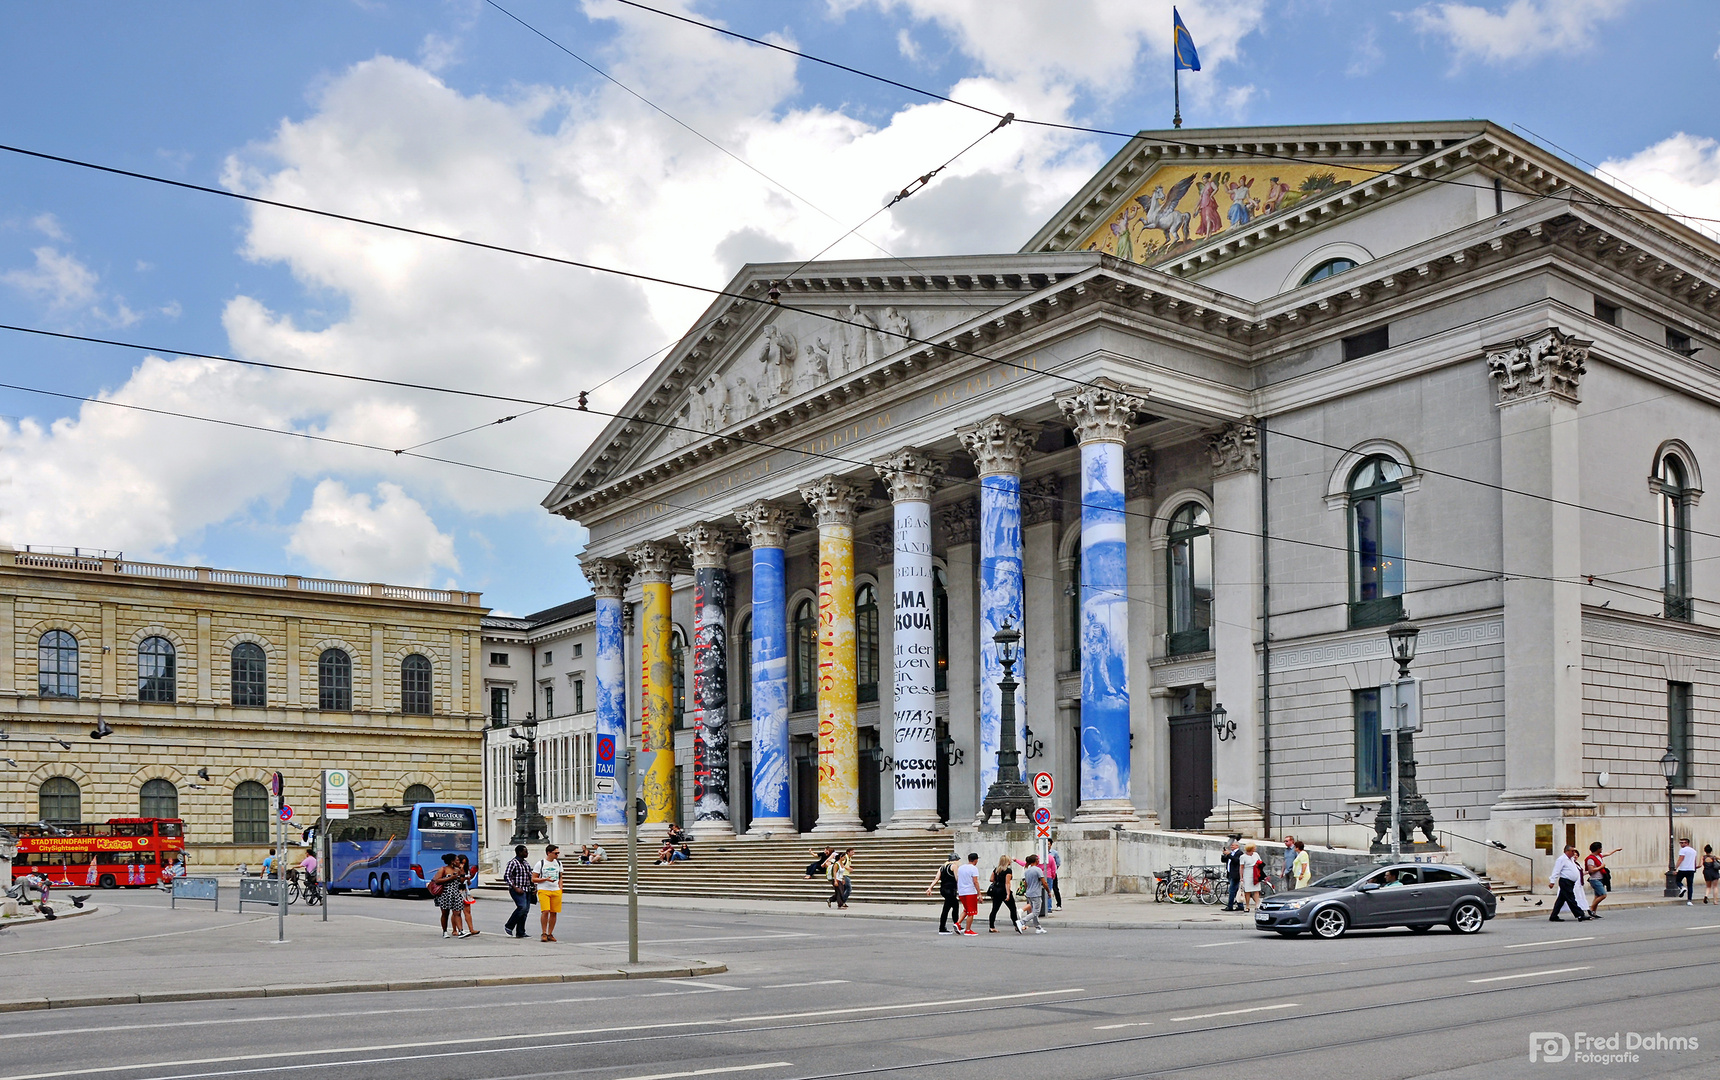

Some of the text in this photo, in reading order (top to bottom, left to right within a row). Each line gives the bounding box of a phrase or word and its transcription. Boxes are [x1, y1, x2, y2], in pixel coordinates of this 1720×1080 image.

[908, 643, 934, 655] der
[894, 709, 933, 726] HTA'S
[597, 763, 614, 774] TAXI
[97, 838, 133, 850] München
